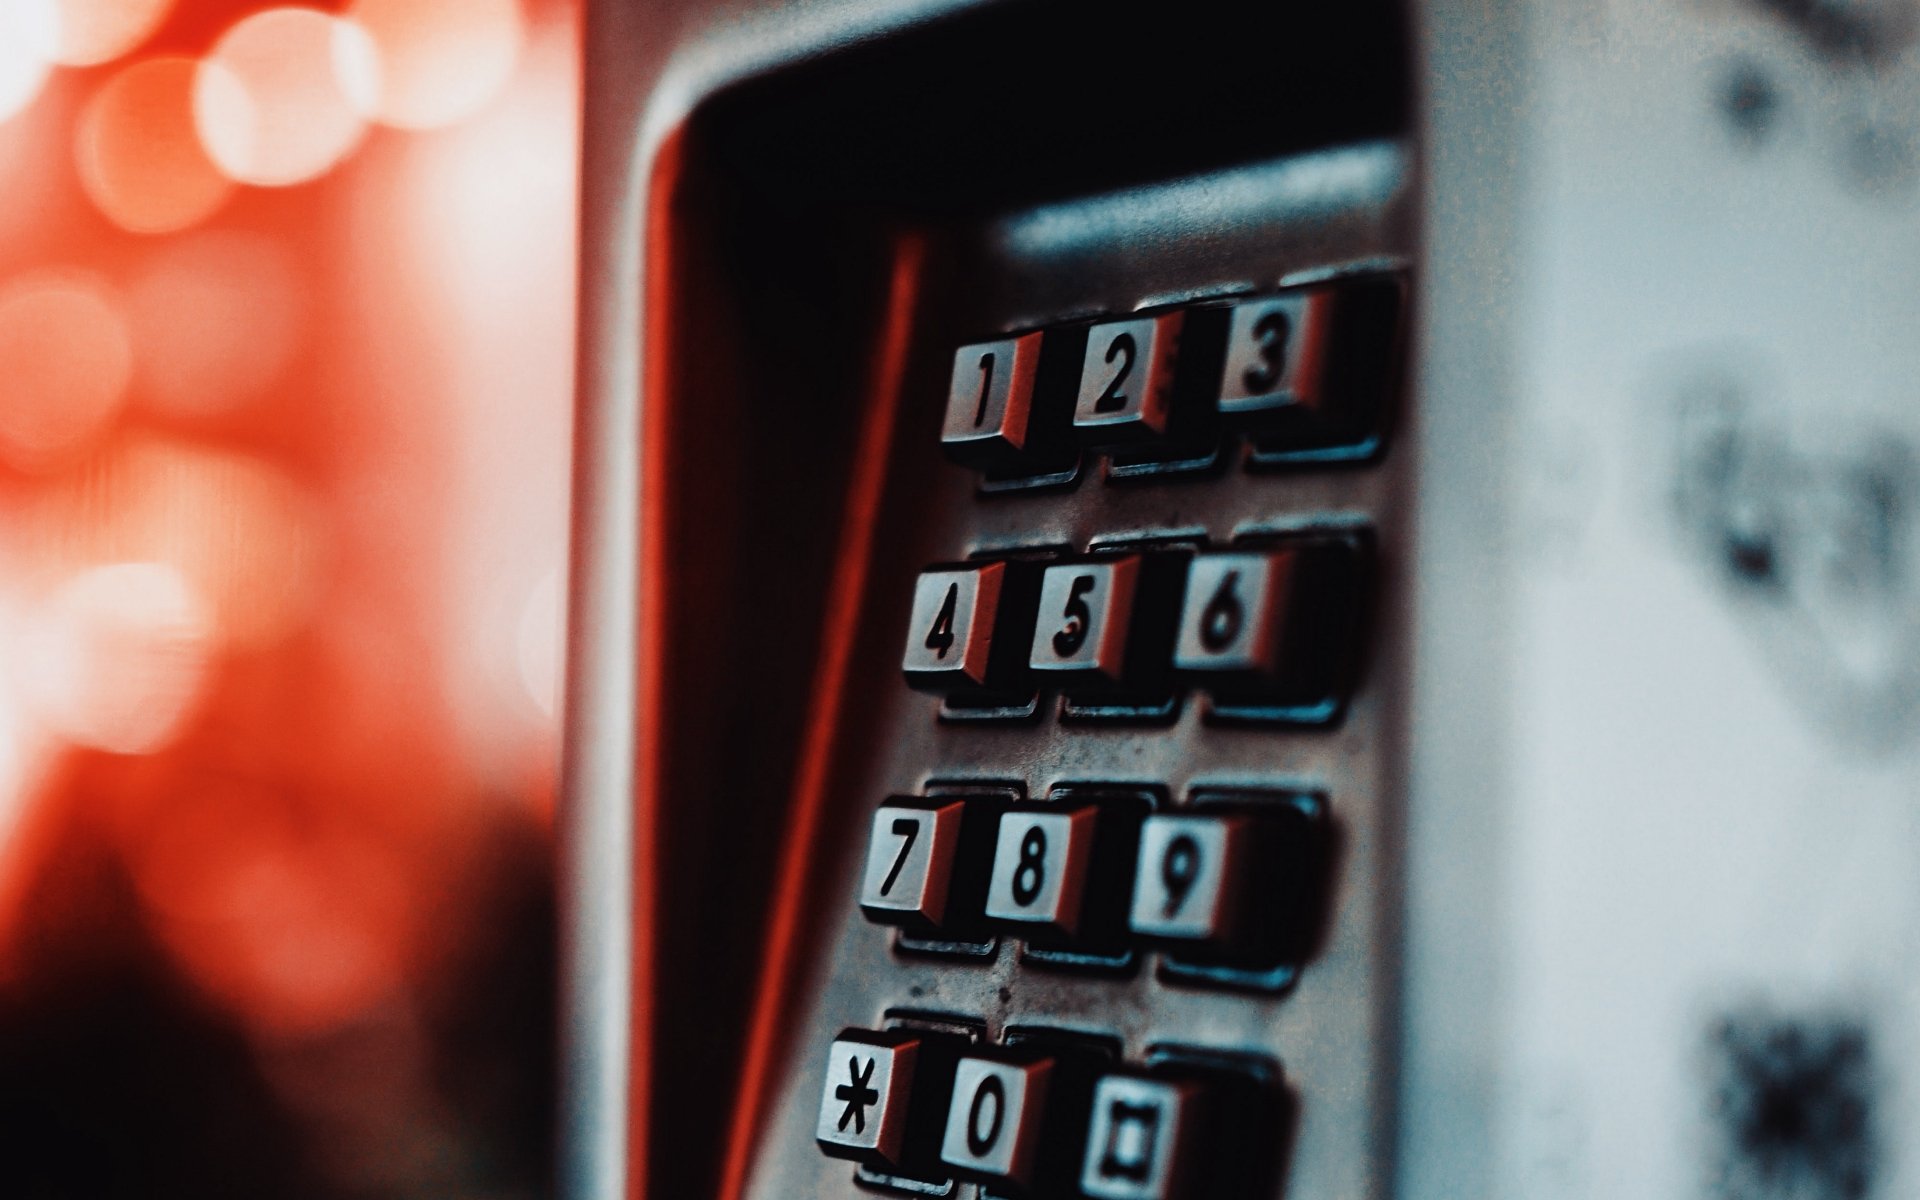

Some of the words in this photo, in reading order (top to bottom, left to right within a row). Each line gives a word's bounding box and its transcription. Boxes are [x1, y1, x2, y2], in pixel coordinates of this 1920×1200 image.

[975, 353, 995, 428] 1
[1094, 333, 1136, 413] 2
[1242, 310, 1290, 395] 3
[925, 582, 958, 659] 4
[1053, 575, 1095, 657] 5
[1200, 570, 1243, 654] 6
[880, 818, 920, 897] 7
[1012, 825, 1047, 907] 8
[1162, 834, 1201, 920] 9
[967, 1073, 1003, 1158] 0
